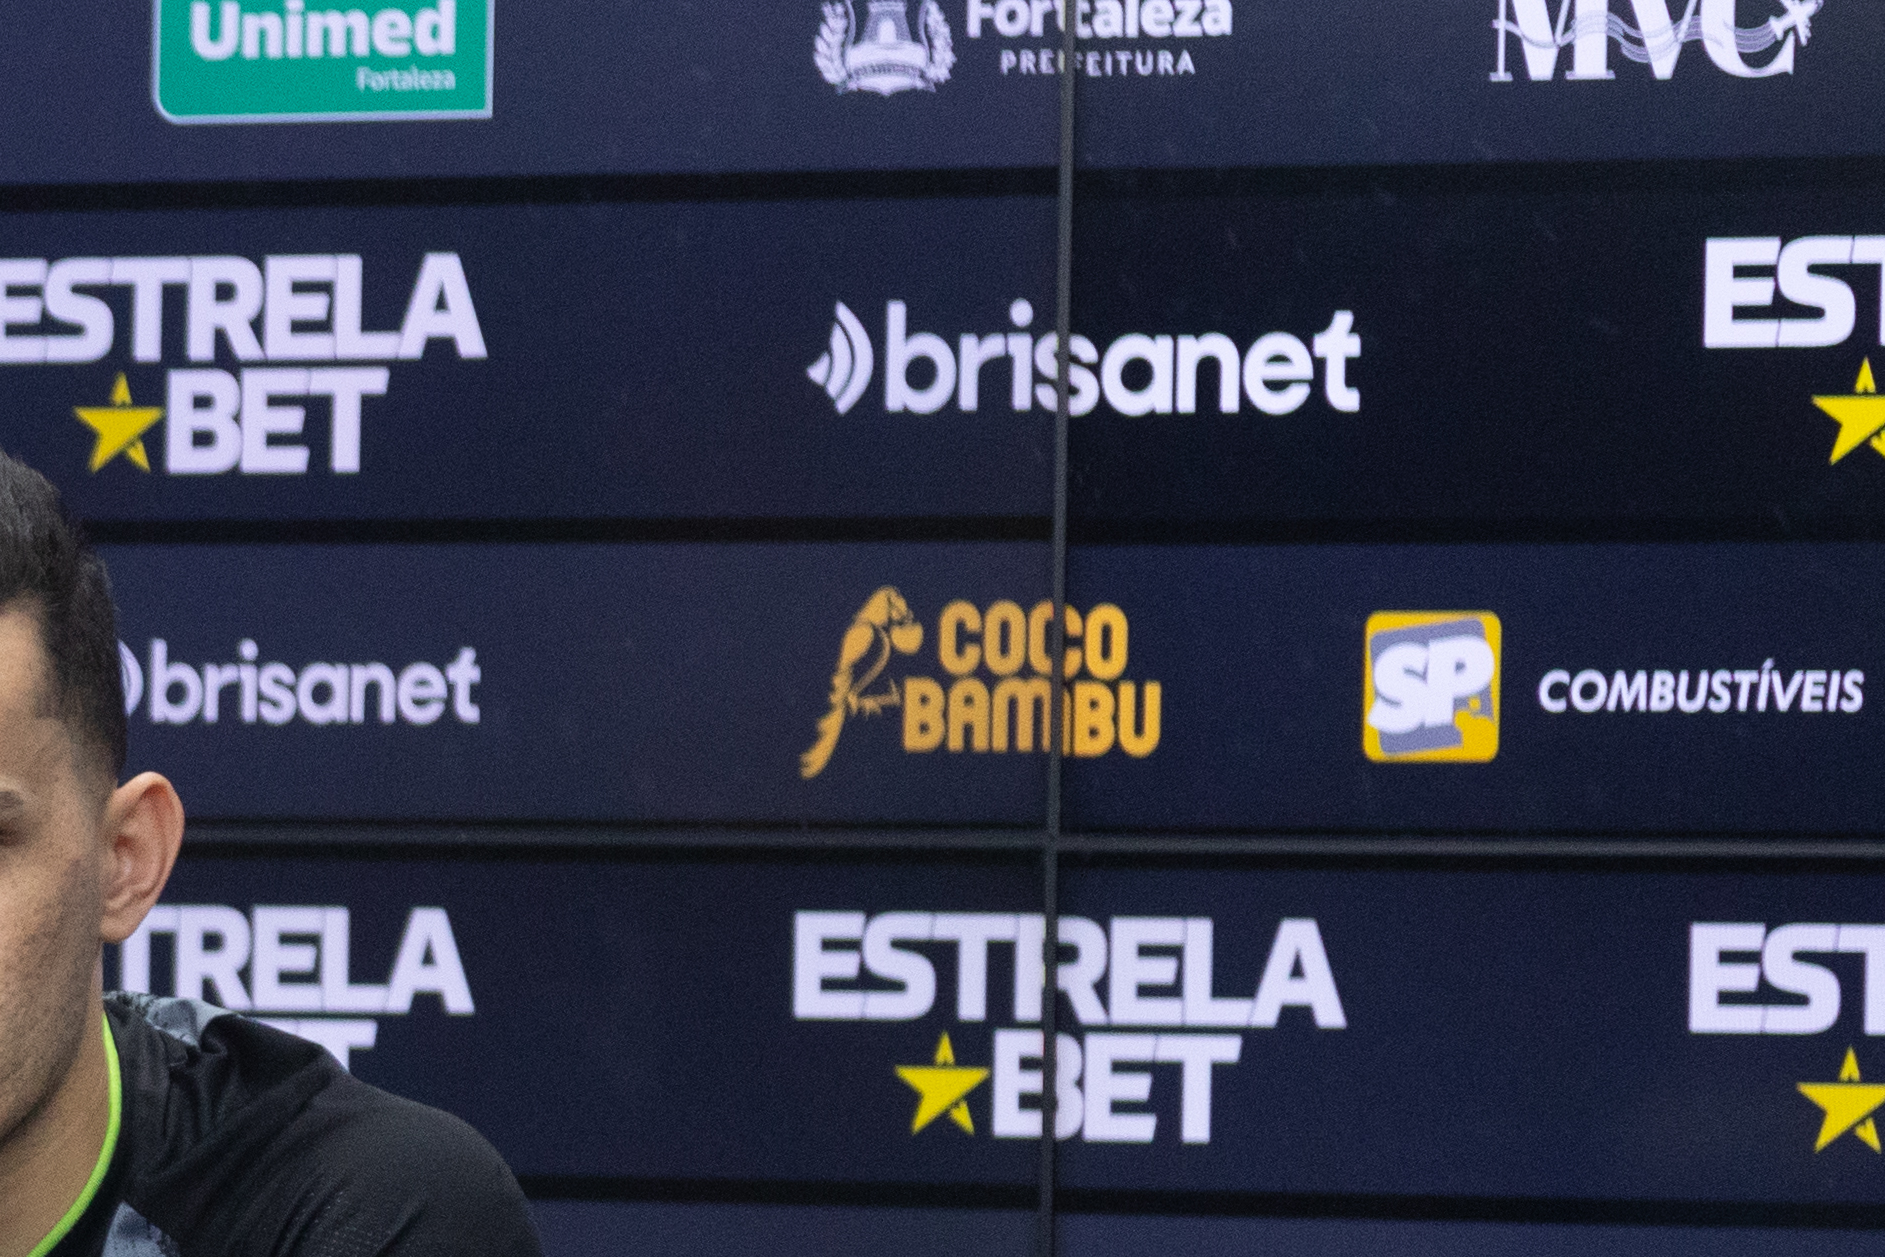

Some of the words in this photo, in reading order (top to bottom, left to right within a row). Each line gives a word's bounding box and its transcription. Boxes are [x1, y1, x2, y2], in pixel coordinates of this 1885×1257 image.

[190, 0, 456, 58] Unimed
[967, 0, 1232, 38] Fortaleza
[1490, 0, 1798, 81] MVC
[356, 66, 456, 91] Fortaleza
[885, 299, 1361, 416] brisanet
[162, 367, 389, 474] BET
[149, 639, 481, 725] brisanet
[939, 601, 1128, 682] COCO
[1368, 632, 1499, 735] SP
[1538, 659, 1864, 713] COMBUSTÍVEIS
[903, 675, 1161, 757] BAMBU
[122, 904, 476, 1015] TRELA
[793, 911, 1348, 1030] ESTRELA
[992, 1029, 1244, 1143] BET
